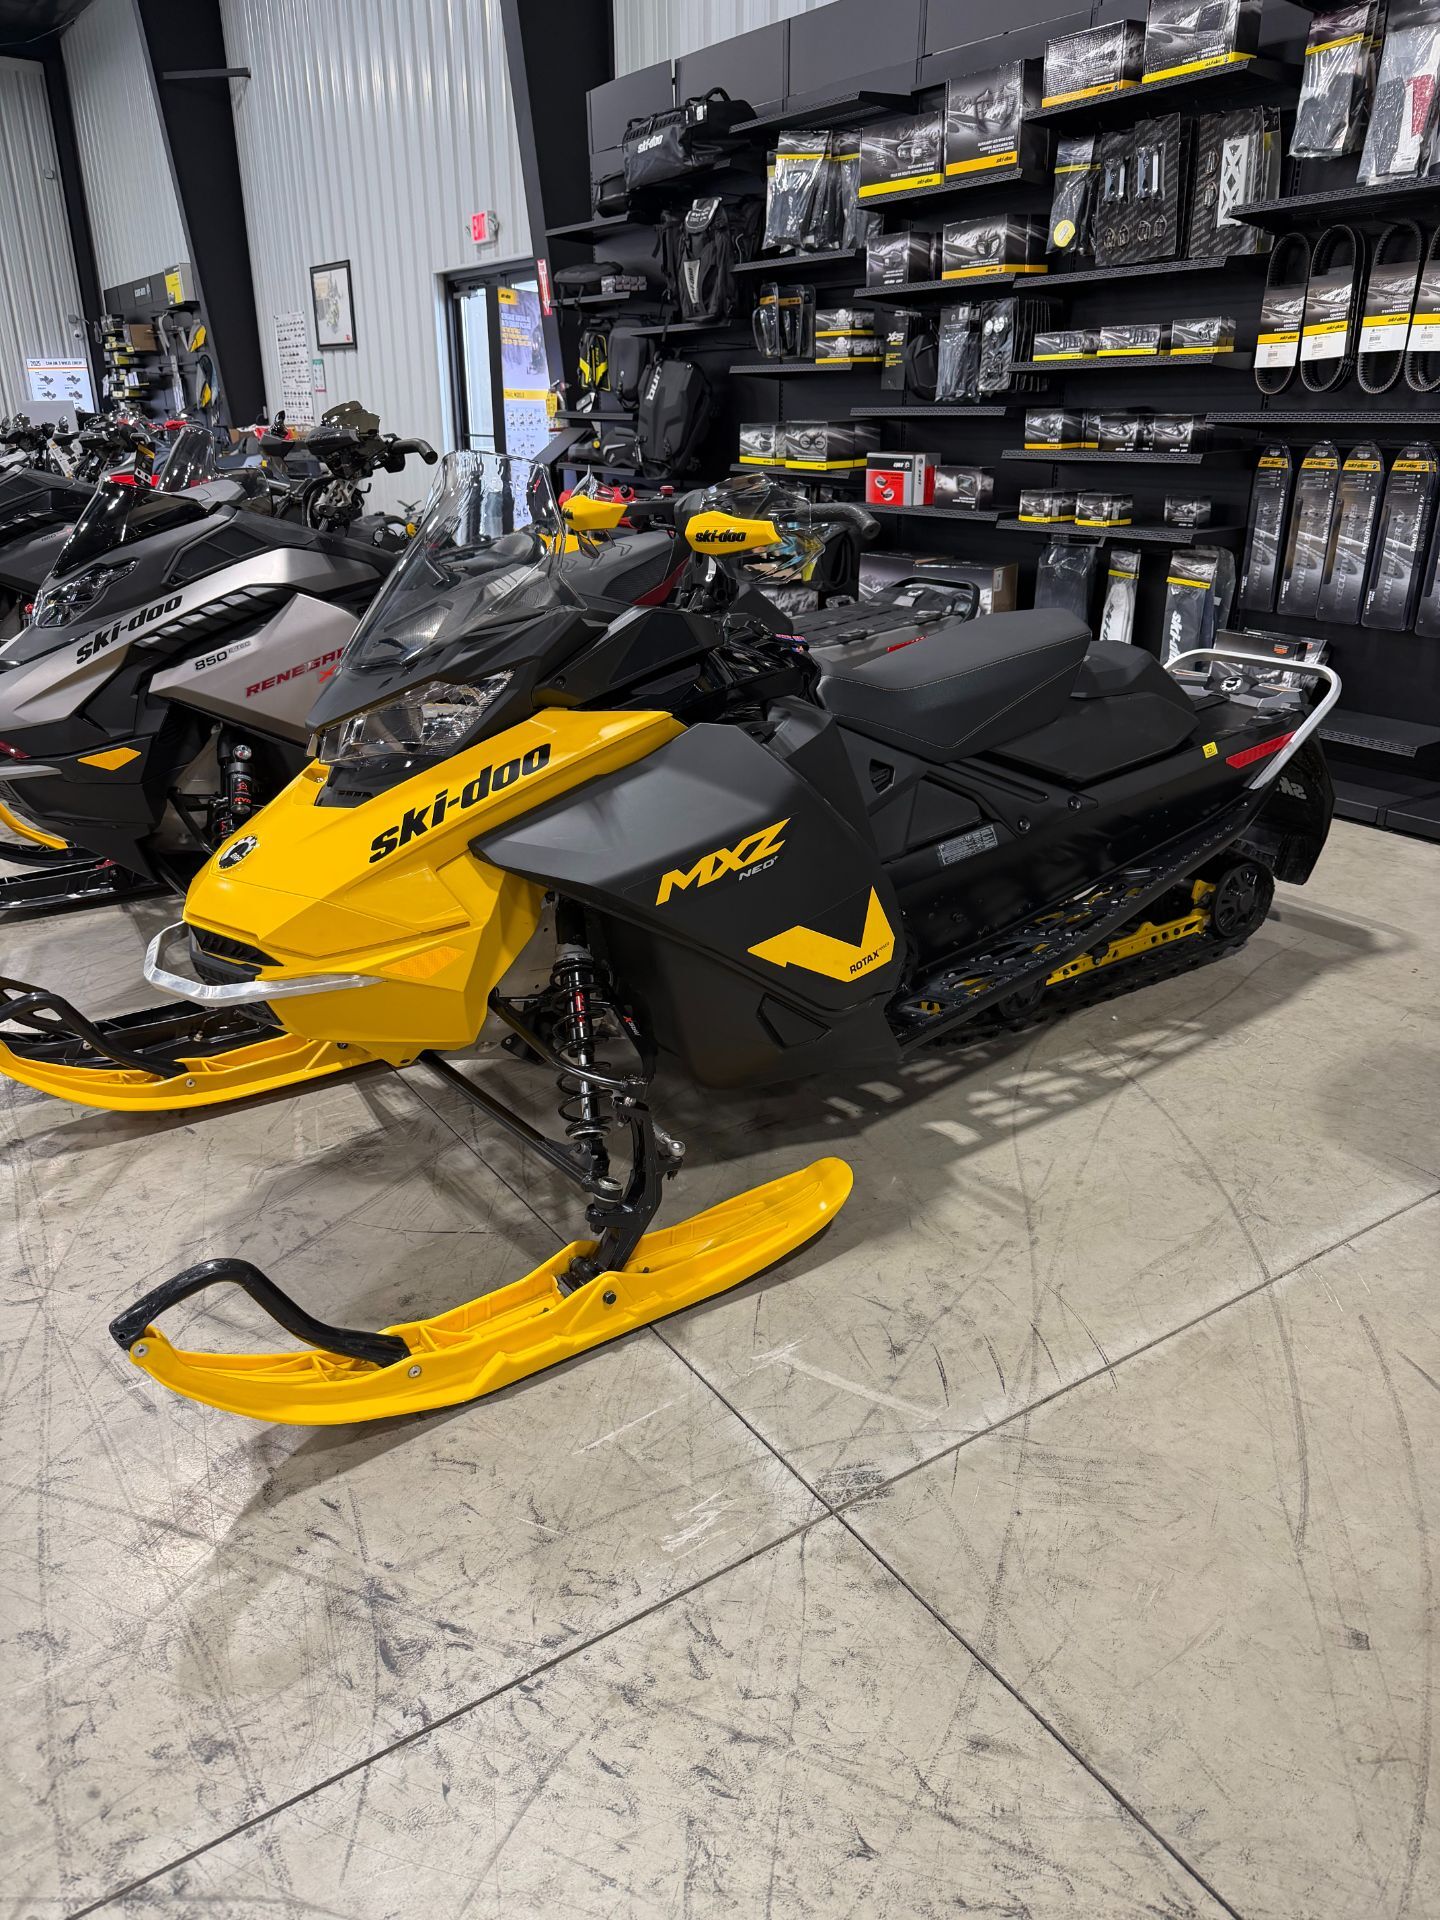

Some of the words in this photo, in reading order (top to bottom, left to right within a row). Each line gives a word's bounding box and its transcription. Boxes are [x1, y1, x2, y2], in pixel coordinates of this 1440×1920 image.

[695, 529, 747, 543] ski-doo
[77, 595, 184, 664] ski-doo
[195, 651, 227, 670] 850
[369, 743, 551, 863] ski-doo
[656, 817, 791, 906] MXZ
[849, 950, 879, 975] ROTAX
